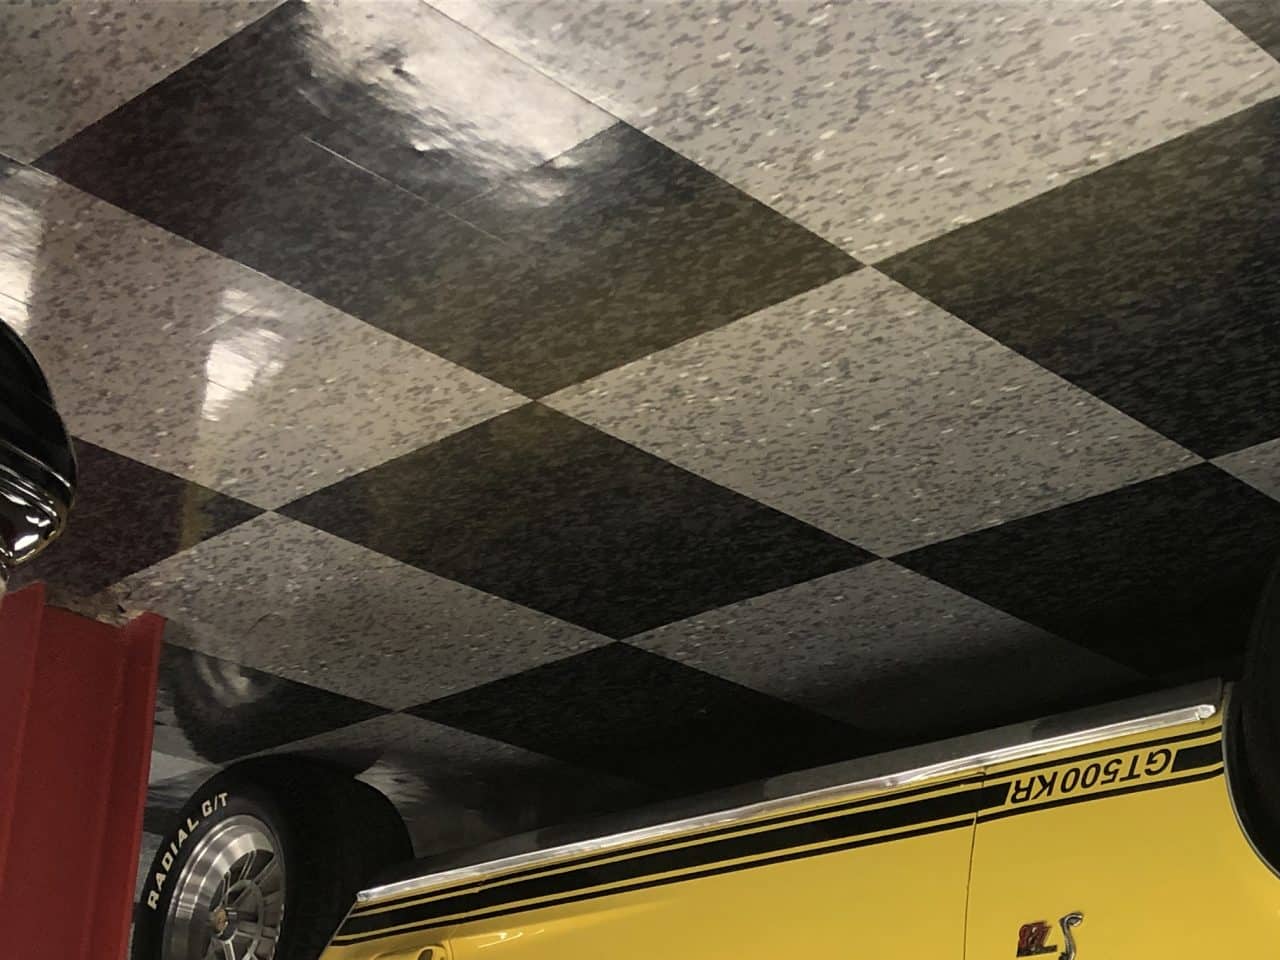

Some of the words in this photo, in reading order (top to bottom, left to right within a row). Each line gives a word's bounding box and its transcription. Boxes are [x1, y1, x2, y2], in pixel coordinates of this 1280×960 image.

[1010, 748, 1172, 804] GT500KR
[147, 817, 199, 911] RADIAL
[202, 792, 228, 817] G/T
